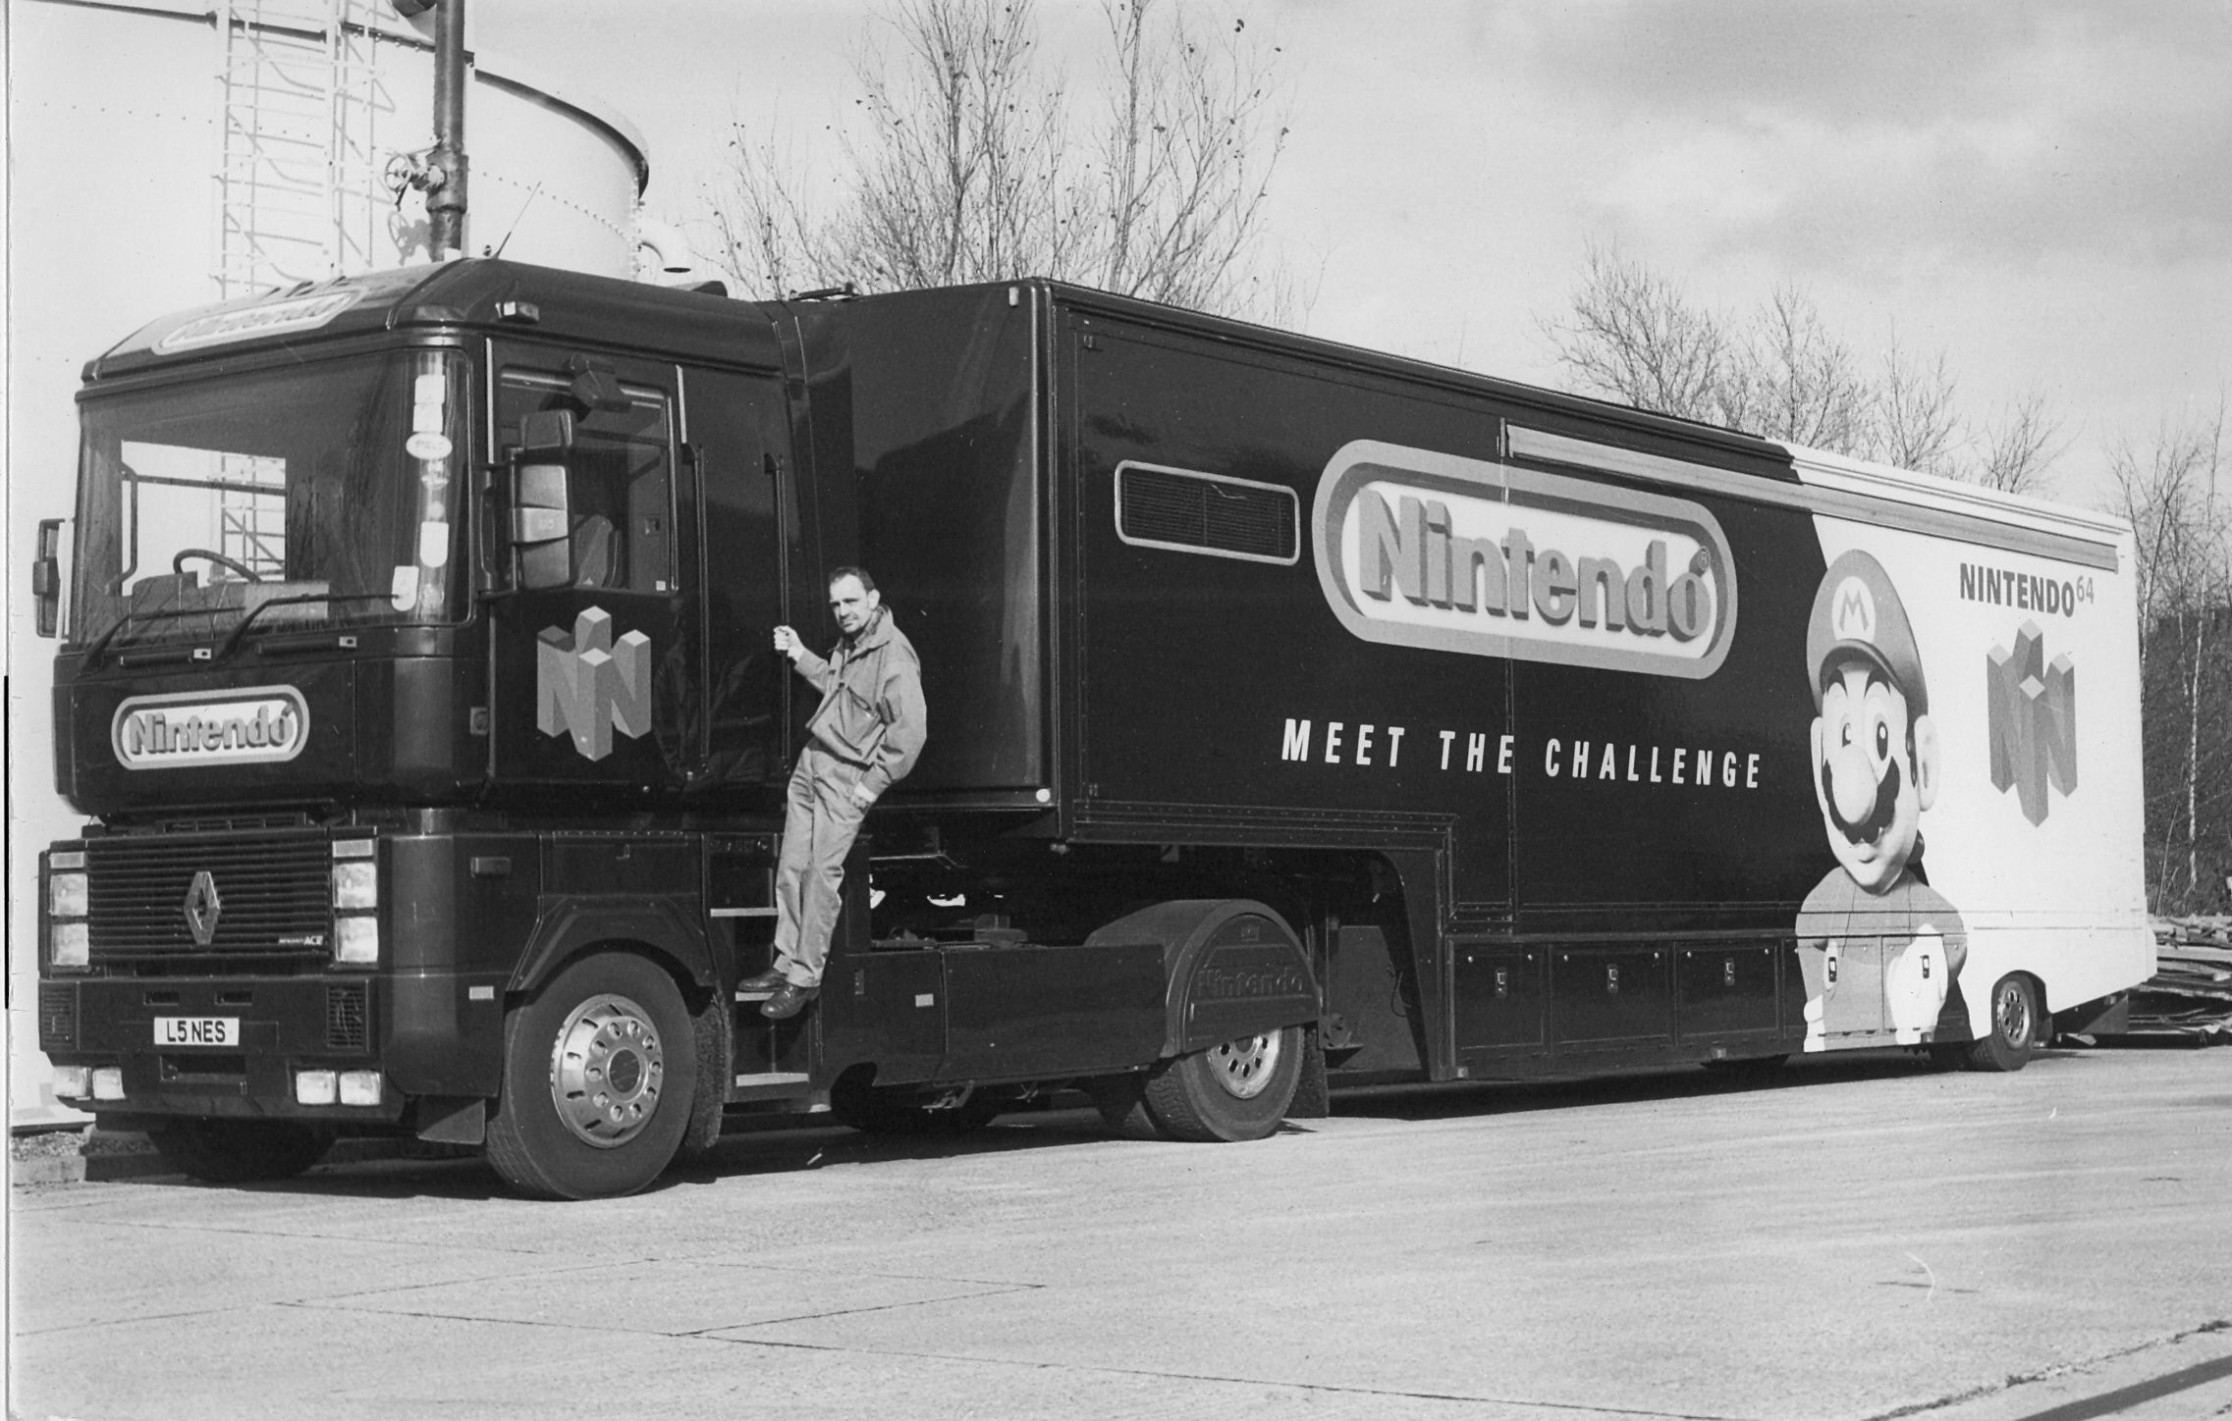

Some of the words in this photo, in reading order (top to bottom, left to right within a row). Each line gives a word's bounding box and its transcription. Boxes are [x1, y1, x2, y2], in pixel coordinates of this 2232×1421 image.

[1838, 589, 1870, 632] M
[128, 704, 294, 756] Nintendo
[1281, 718, 1405, 768] MEET
[1439, 730, 1515, 774] THE
[1545, 738, 1761, 788] CHALLENGE
[166, 1019, 188, 1043] L5
[191, 1019, 226, 1044] NES
